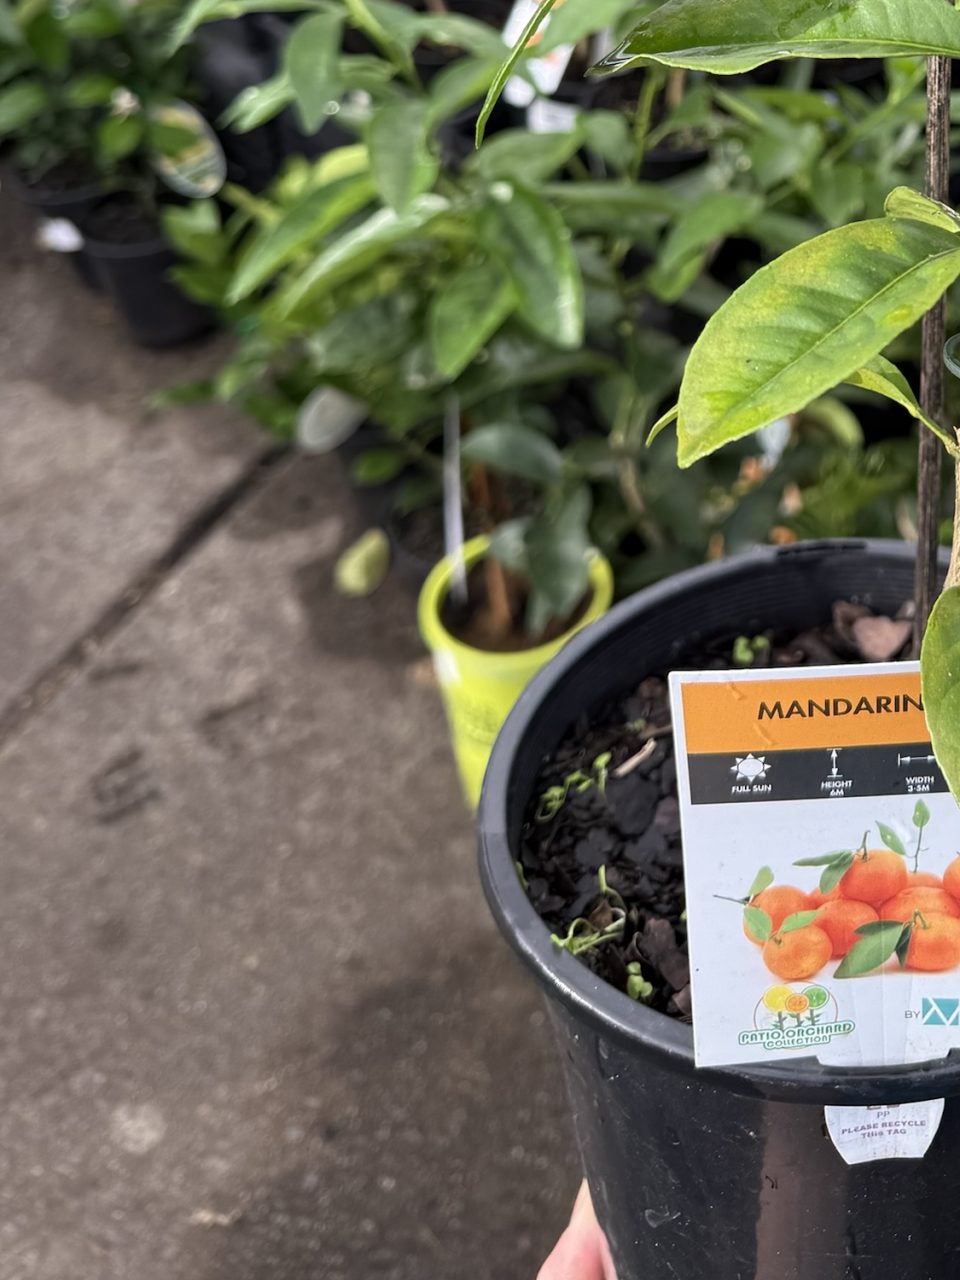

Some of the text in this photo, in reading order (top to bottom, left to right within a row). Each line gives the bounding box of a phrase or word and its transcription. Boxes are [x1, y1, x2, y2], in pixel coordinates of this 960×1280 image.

[757, 693, 924, 720] MANDARIN
[820, 780, 853, 789] HEIGHT
[905, 775, 935, 785] WIDTH
[731, 784, 772, 794] FULL SUN
[829, 788, 845, 797] 6M
[904, 1010, 921, 1019] BY
[785, 1022, 853, 1038] ORCHARD
[765, 1034, 832, 1048] COLLECTION
[841, 1119, 927, 1135] PLEASE RECYCLE
[887, 1128, 908, 1136] TAG
